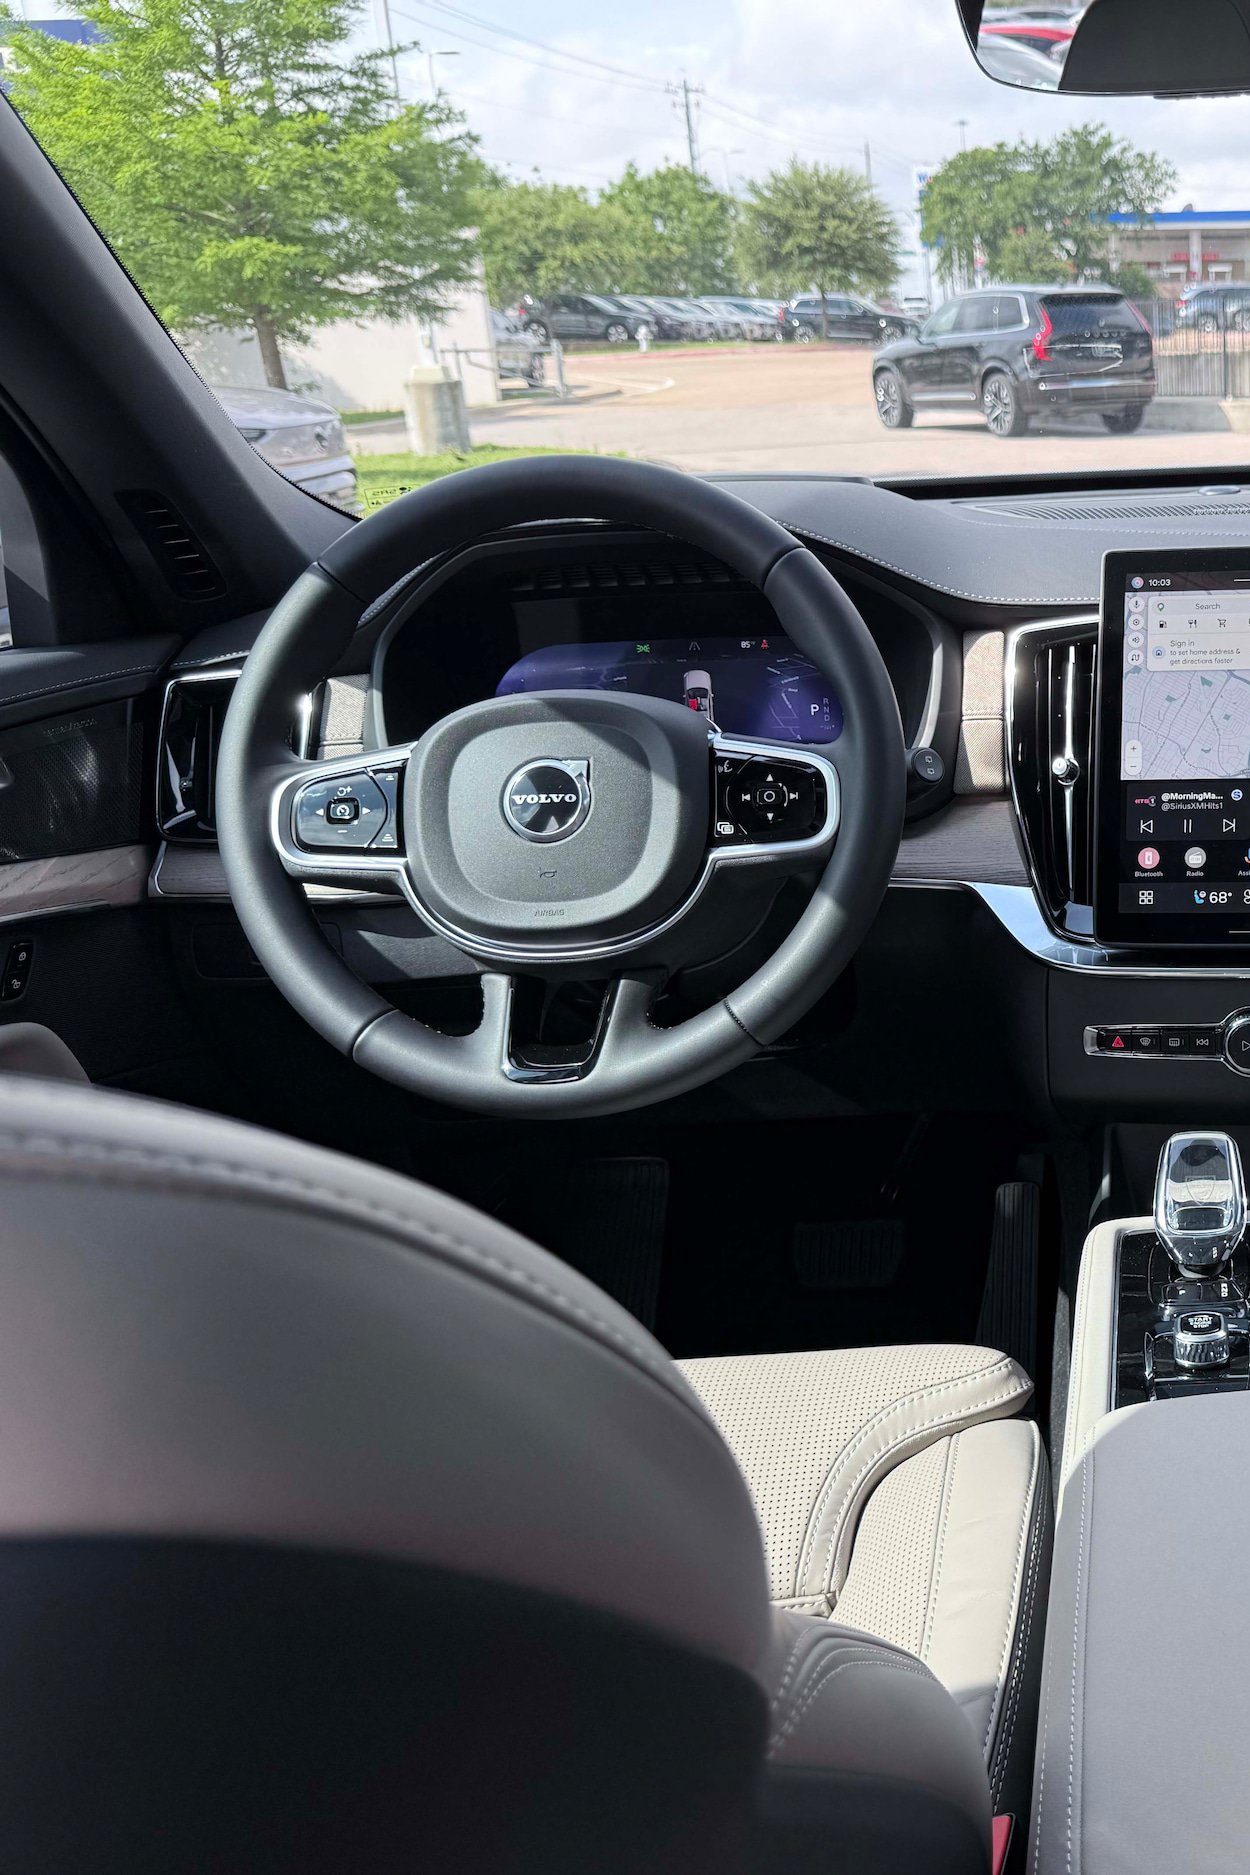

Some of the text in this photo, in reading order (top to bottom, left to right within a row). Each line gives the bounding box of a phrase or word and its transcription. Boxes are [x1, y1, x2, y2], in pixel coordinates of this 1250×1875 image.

[1170, 640, 1186, 648] Sign
[810, 704, 820, 716] P
[511, 793, 577, 804] VOLVO
[1161, 801, 1223, 811] @SiriusXMHits1
[1209, 891, 1232, 904] 68°
[534, 908, 565, 917] AIRBAG
